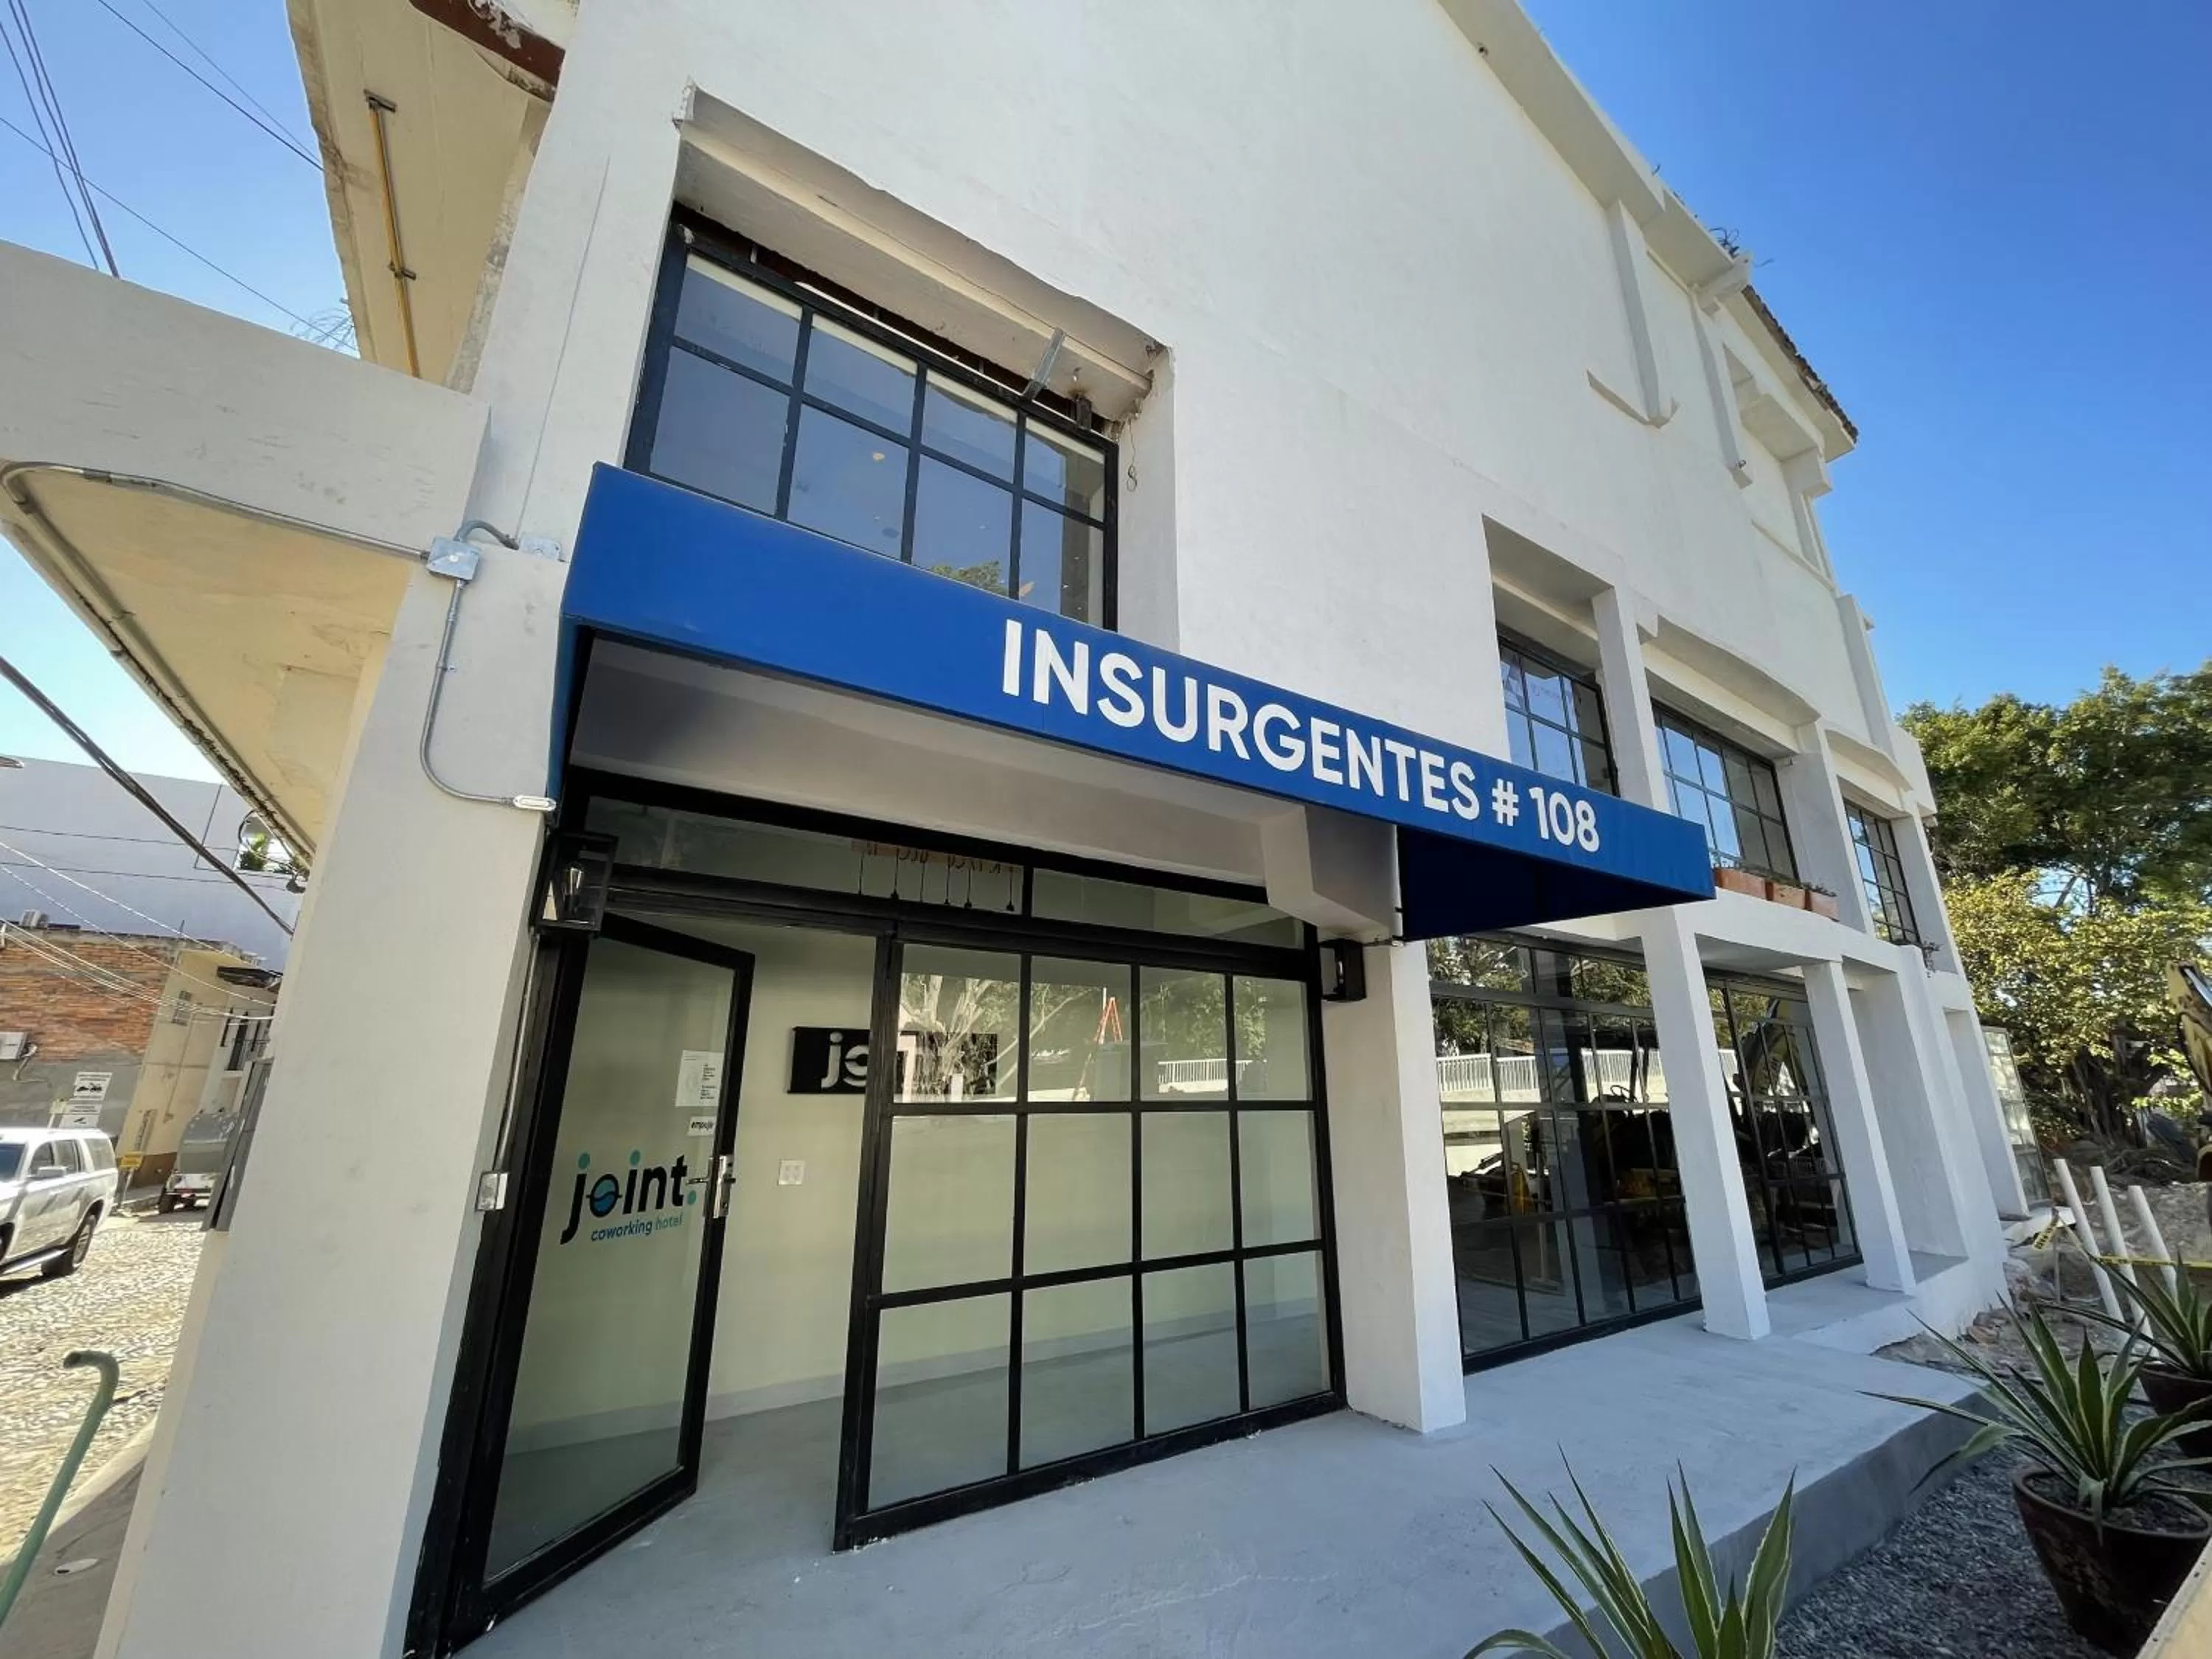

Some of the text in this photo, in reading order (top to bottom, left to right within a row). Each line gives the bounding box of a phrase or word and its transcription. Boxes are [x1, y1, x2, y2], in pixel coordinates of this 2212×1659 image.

[1003, 619, 1600, 852] INSURGENTES # 108
[591, 1213, 683, 1242] coworking hotel
